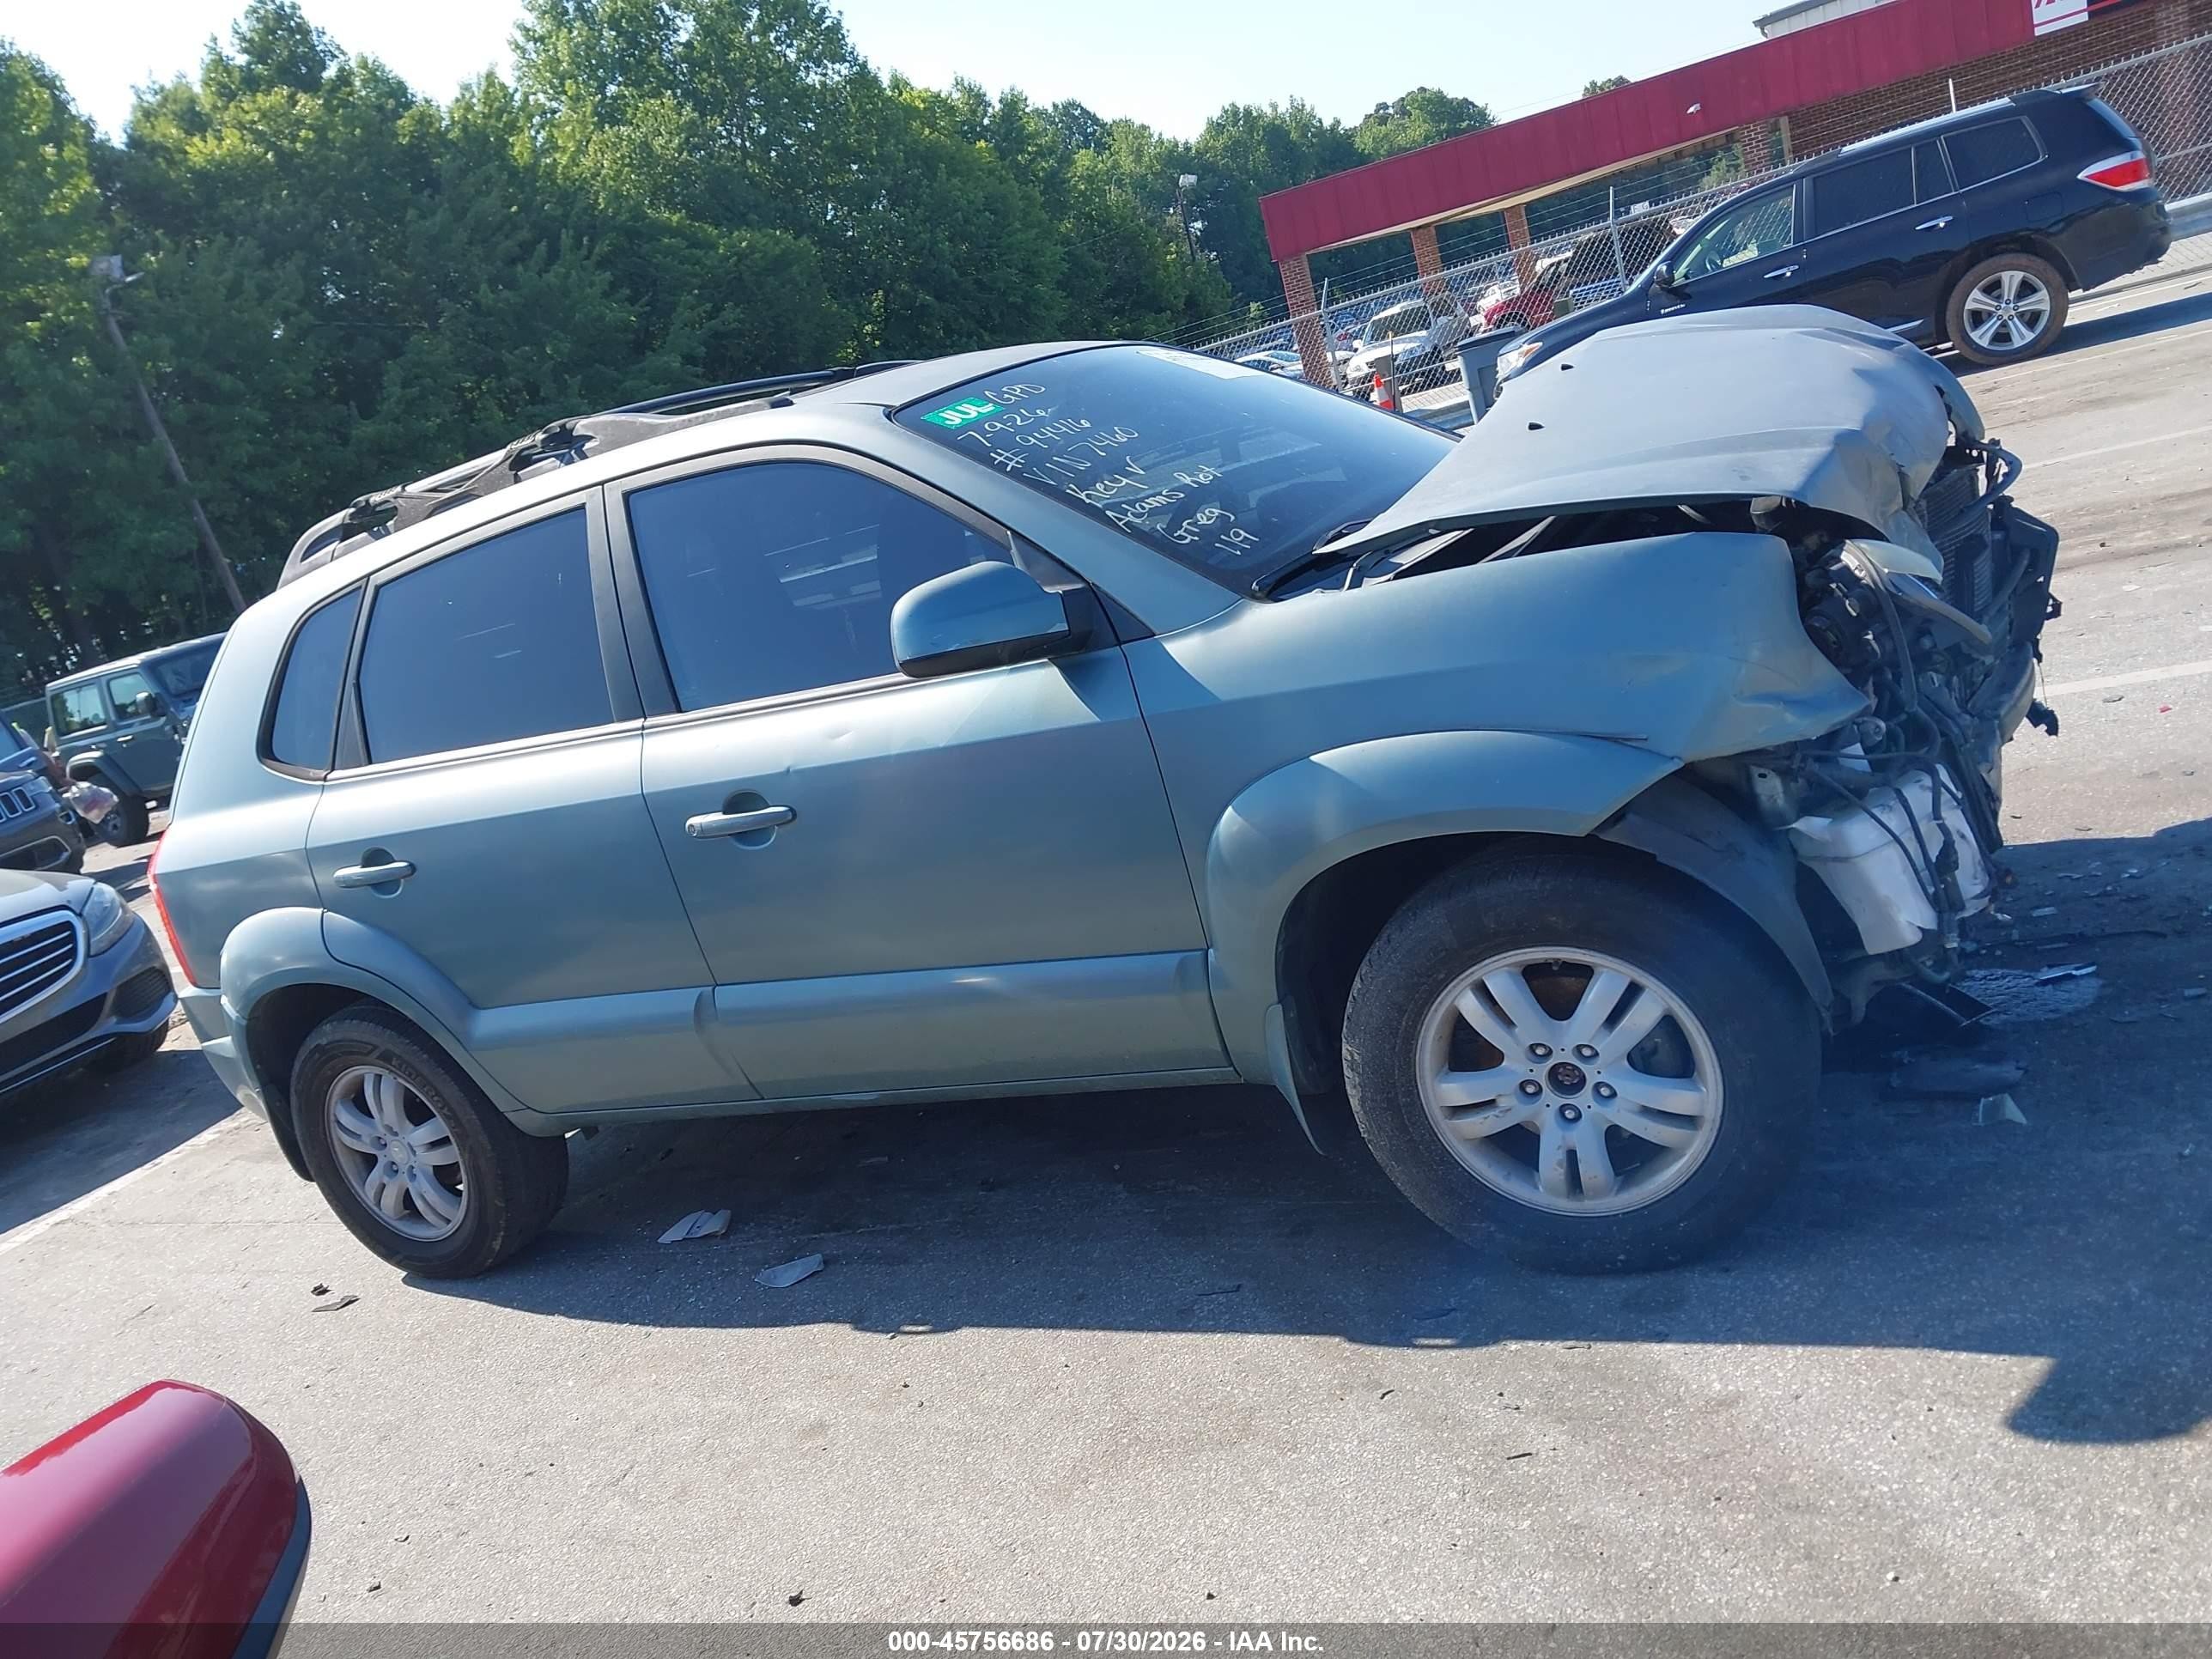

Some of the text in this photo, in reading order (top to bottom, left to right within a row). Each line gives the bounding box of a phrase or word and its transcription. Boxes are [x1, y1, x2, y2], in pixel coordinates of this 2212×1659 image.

[984, 384, 1047, 404] GPD
[939, 403, 995, 425] JUL
[1023, 454, 1092, 485] VIN
[1157, 507, 1235, 544] Greg
